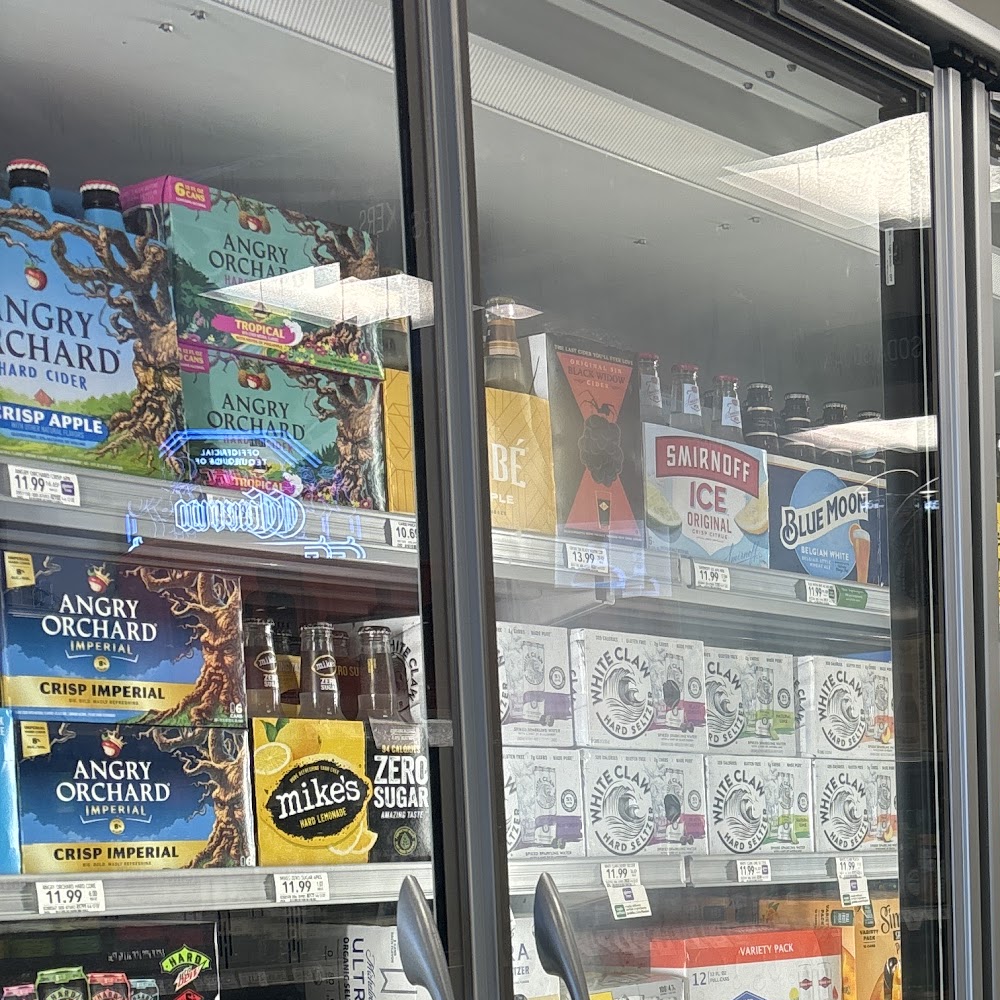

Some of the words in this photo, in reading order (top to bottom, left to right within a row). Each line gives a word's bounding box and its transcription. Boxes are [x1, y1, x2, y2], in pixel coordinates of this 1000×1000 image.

[223, 234, 288, 265] ANGRY
[0, 294, 94, 340] NGRY
[235, 319, 285, 339] TROPICAL
[568, 366, 593, 380] BLACK
[570, 358, 607, 373] ORIGINAL
[0, 362, 37, 378] HARD
[46, 370, 88, 391] CIDER
[222, 393, 290, 419] ANGRY
[49, 413, 103, 434] APPLE
[207, 411, 305, 441] ORCHARD
[666, 445, 751, 483] SMIRNOFF
[689, 481, 727, 513] ICE
[687, 512, 732, 534] ORIGINAL
[781, 502, 825, 546] BLUE
[825, 491, 868, 526] MOON
[572, 551, 595, 564] 13.99
[801, 546, 828, 557] BELGIAN
[830, 549, 850, 561] WHITE
[699, 570, 719, 582] 11.99
[59, 594, 139, 619] ANGRY
[42, 615, 157, 642] ORCHARD
[70, 640, 133, 655] IMPERIAL
[591, 649, 614, 705] WHITE
[614, 647, 651, 678] CLAW
[40, 682, 87, 696] CRISP
[92, 684, 165, 700] IMPERIAL
[73, 759, 152, 780] ANGRY
[374, 755, 429, 784] ZERO
[55, 781, 170, 803] ORCHARD
[276, 775, 361, 819] mike's
[374, 786, 429, 808] SUGAR
[590, 768, 614, 824] WHITE
[614, 765, 651, 795] CLAW
[84, 803, 147, 817] IMPERIAL
[300, 818, 316, 828] HARD
[318, 807, 347, 824] LEMONADE
[381, 811, 406, 819] AMAZING
[407, 810, 423, 818] TASTE
[53, 846, 104, 861] CRISP
[107, 845, 179, 859] IMPERIAL
[606, 868, 628, 880] 11.99
[45, 889, 83, 905] 11.99
[282, 881, 311, 893] 11.99
[168, 952, 202, 967] HARD
[739, 945, 772, 956] VARIETY
[774, 943, 794, 953] PACK
